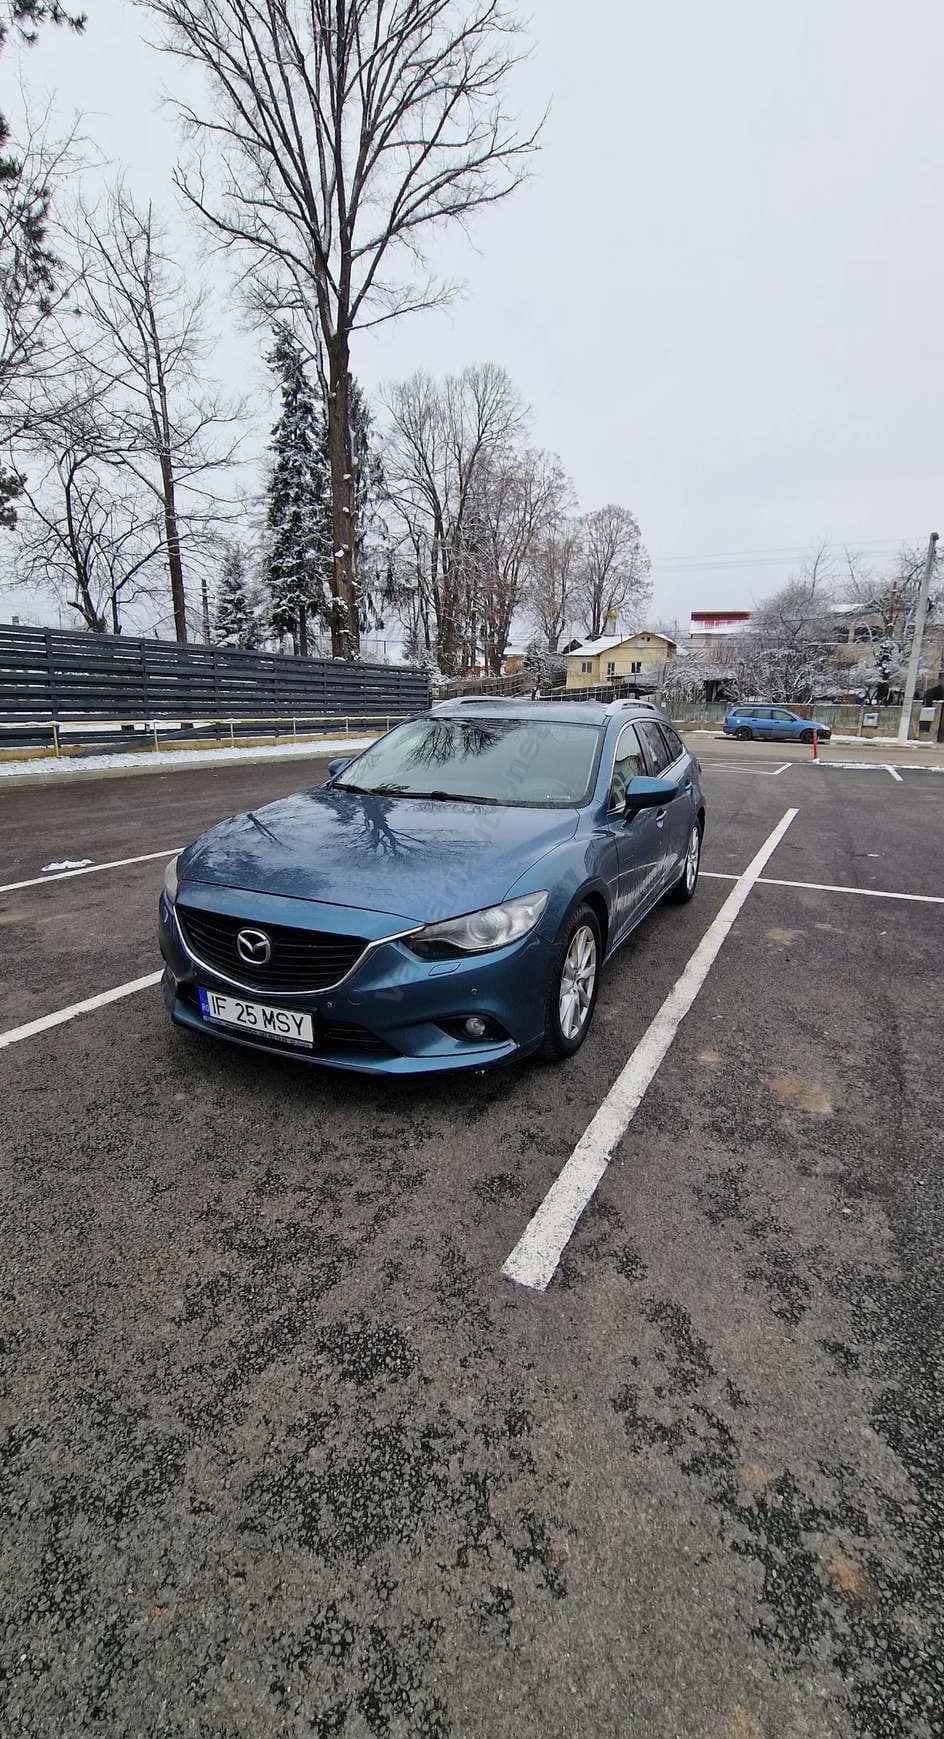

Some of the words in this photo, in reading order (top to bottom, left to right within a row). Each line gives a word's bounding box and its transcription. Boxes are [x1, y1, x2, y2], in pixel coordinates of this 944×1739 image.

[211, 995, 227, 1016] IF
[235, 1003, 257, 1026] 25
[262, 1009, 304, 1036] MSY
